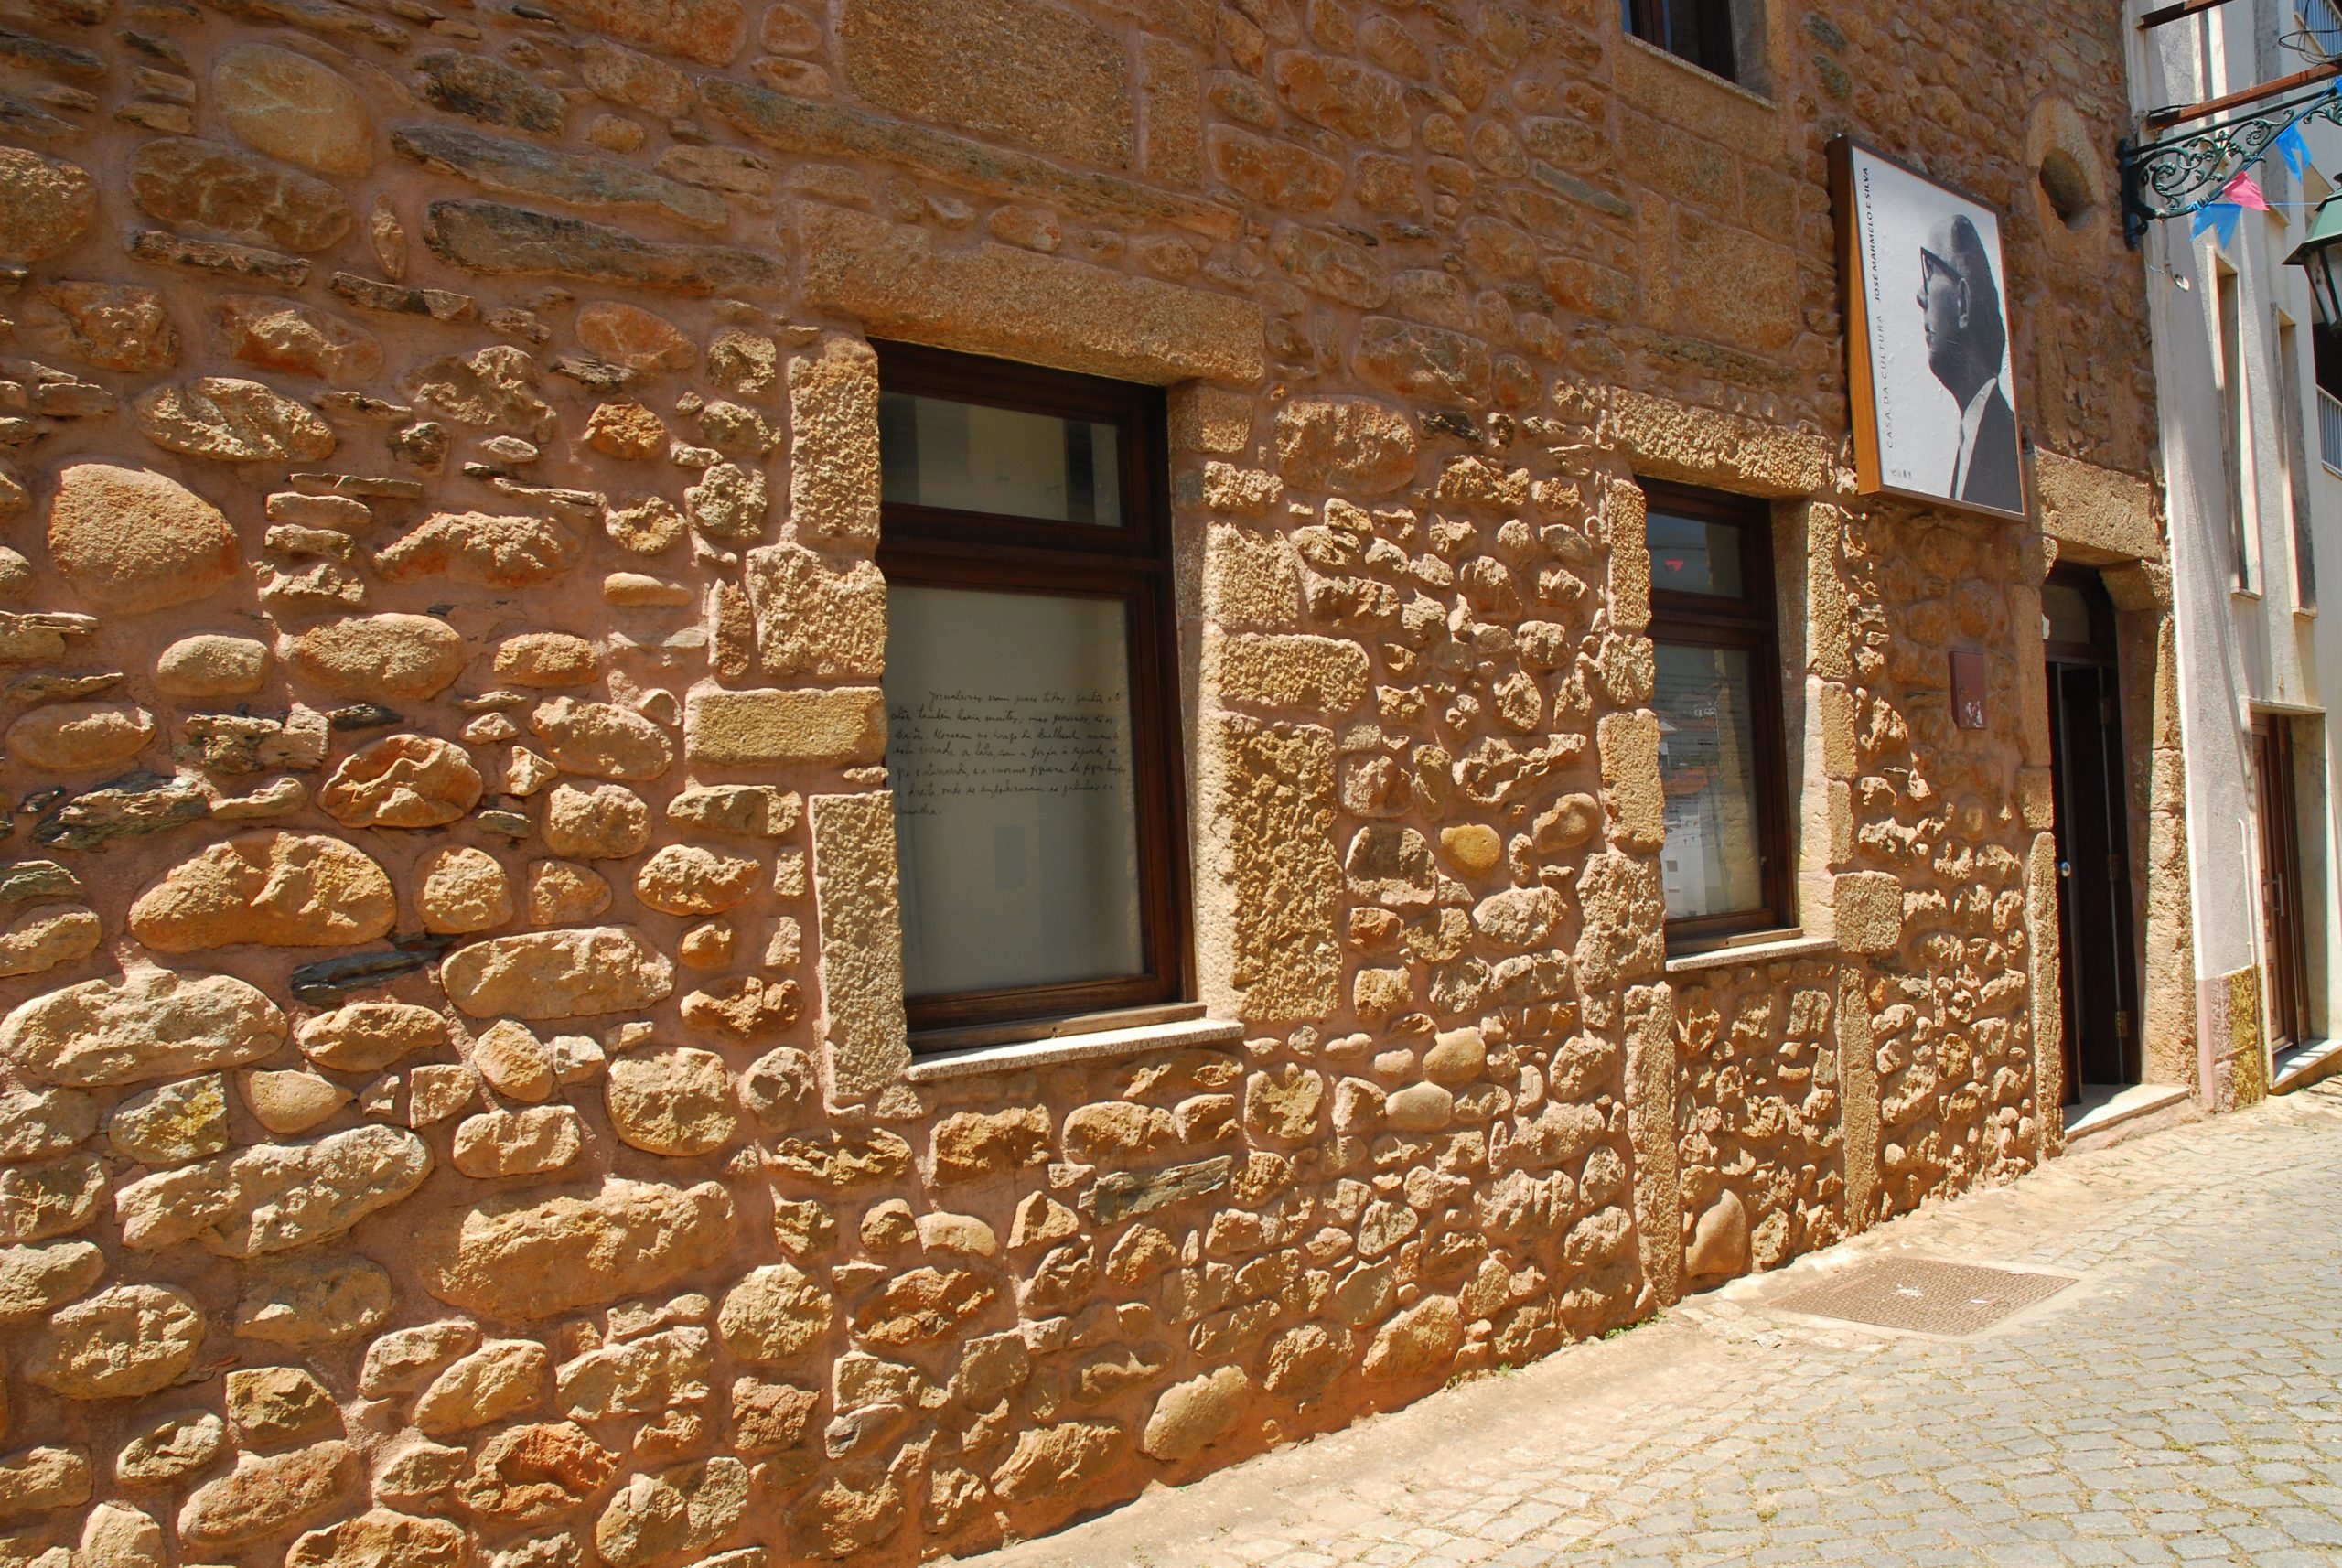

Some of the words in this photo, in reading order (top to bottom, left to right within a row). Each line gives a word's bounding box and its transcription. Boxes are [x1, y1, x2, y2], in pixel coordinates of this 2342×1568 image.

[1863, 167, 1871, 199] SILVA
[1866, 211, 1877, 272] MARMELO
[1876, 315, 1887, 380] CULTURA
[1883, 387, 1889, 404] DA
[1885, 412, 1894, 448] CASA
